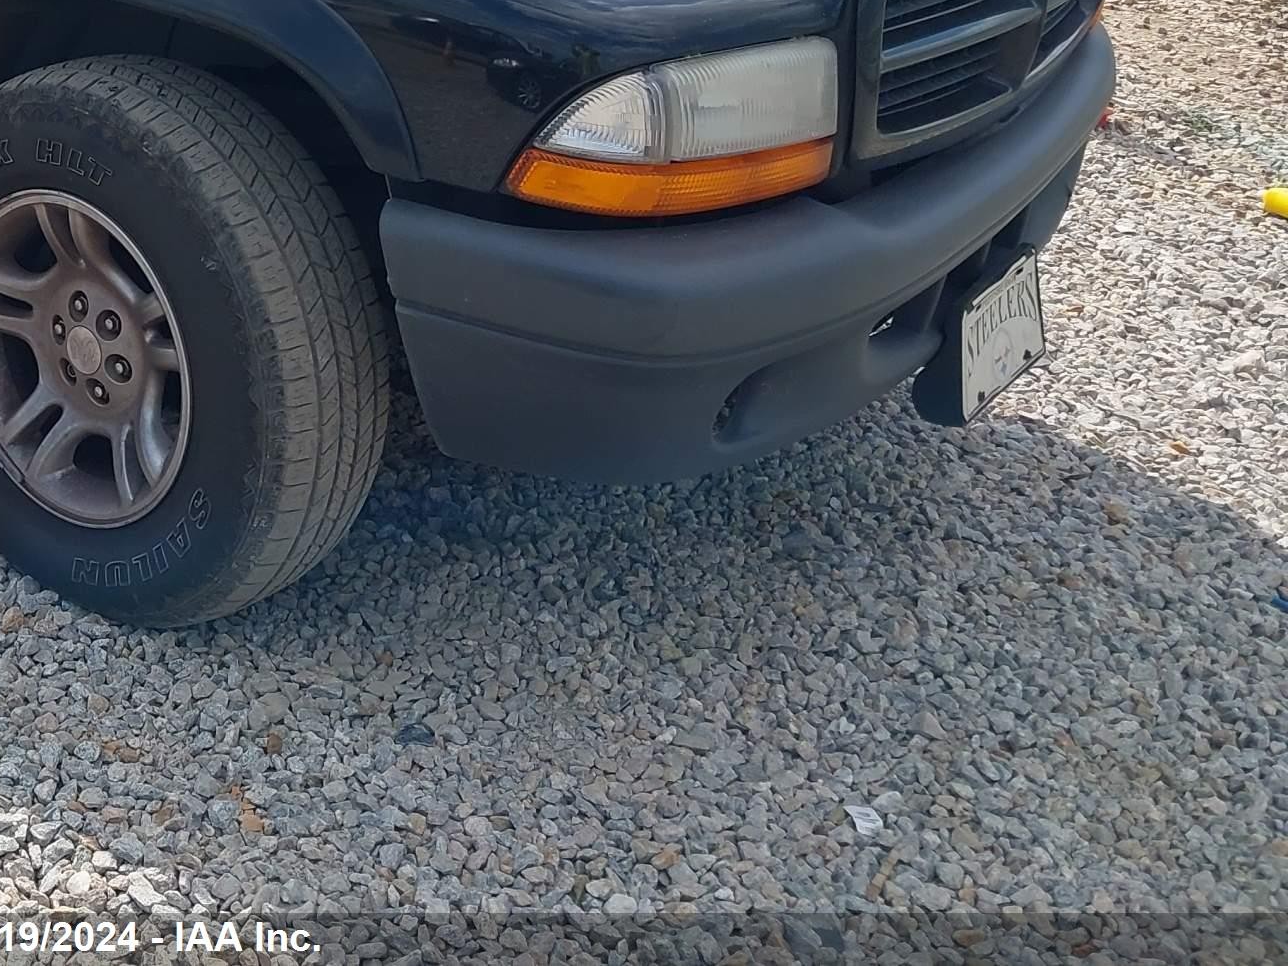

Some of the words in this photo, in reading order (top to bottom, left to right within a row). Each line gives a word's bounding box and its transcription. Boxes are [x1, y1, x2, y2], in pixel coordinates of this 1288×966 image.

[35, 137, 112, 186] HLT
[967, 272, 1038, 377] STEELERS
[71, 487, 212, 587] SAILUN
